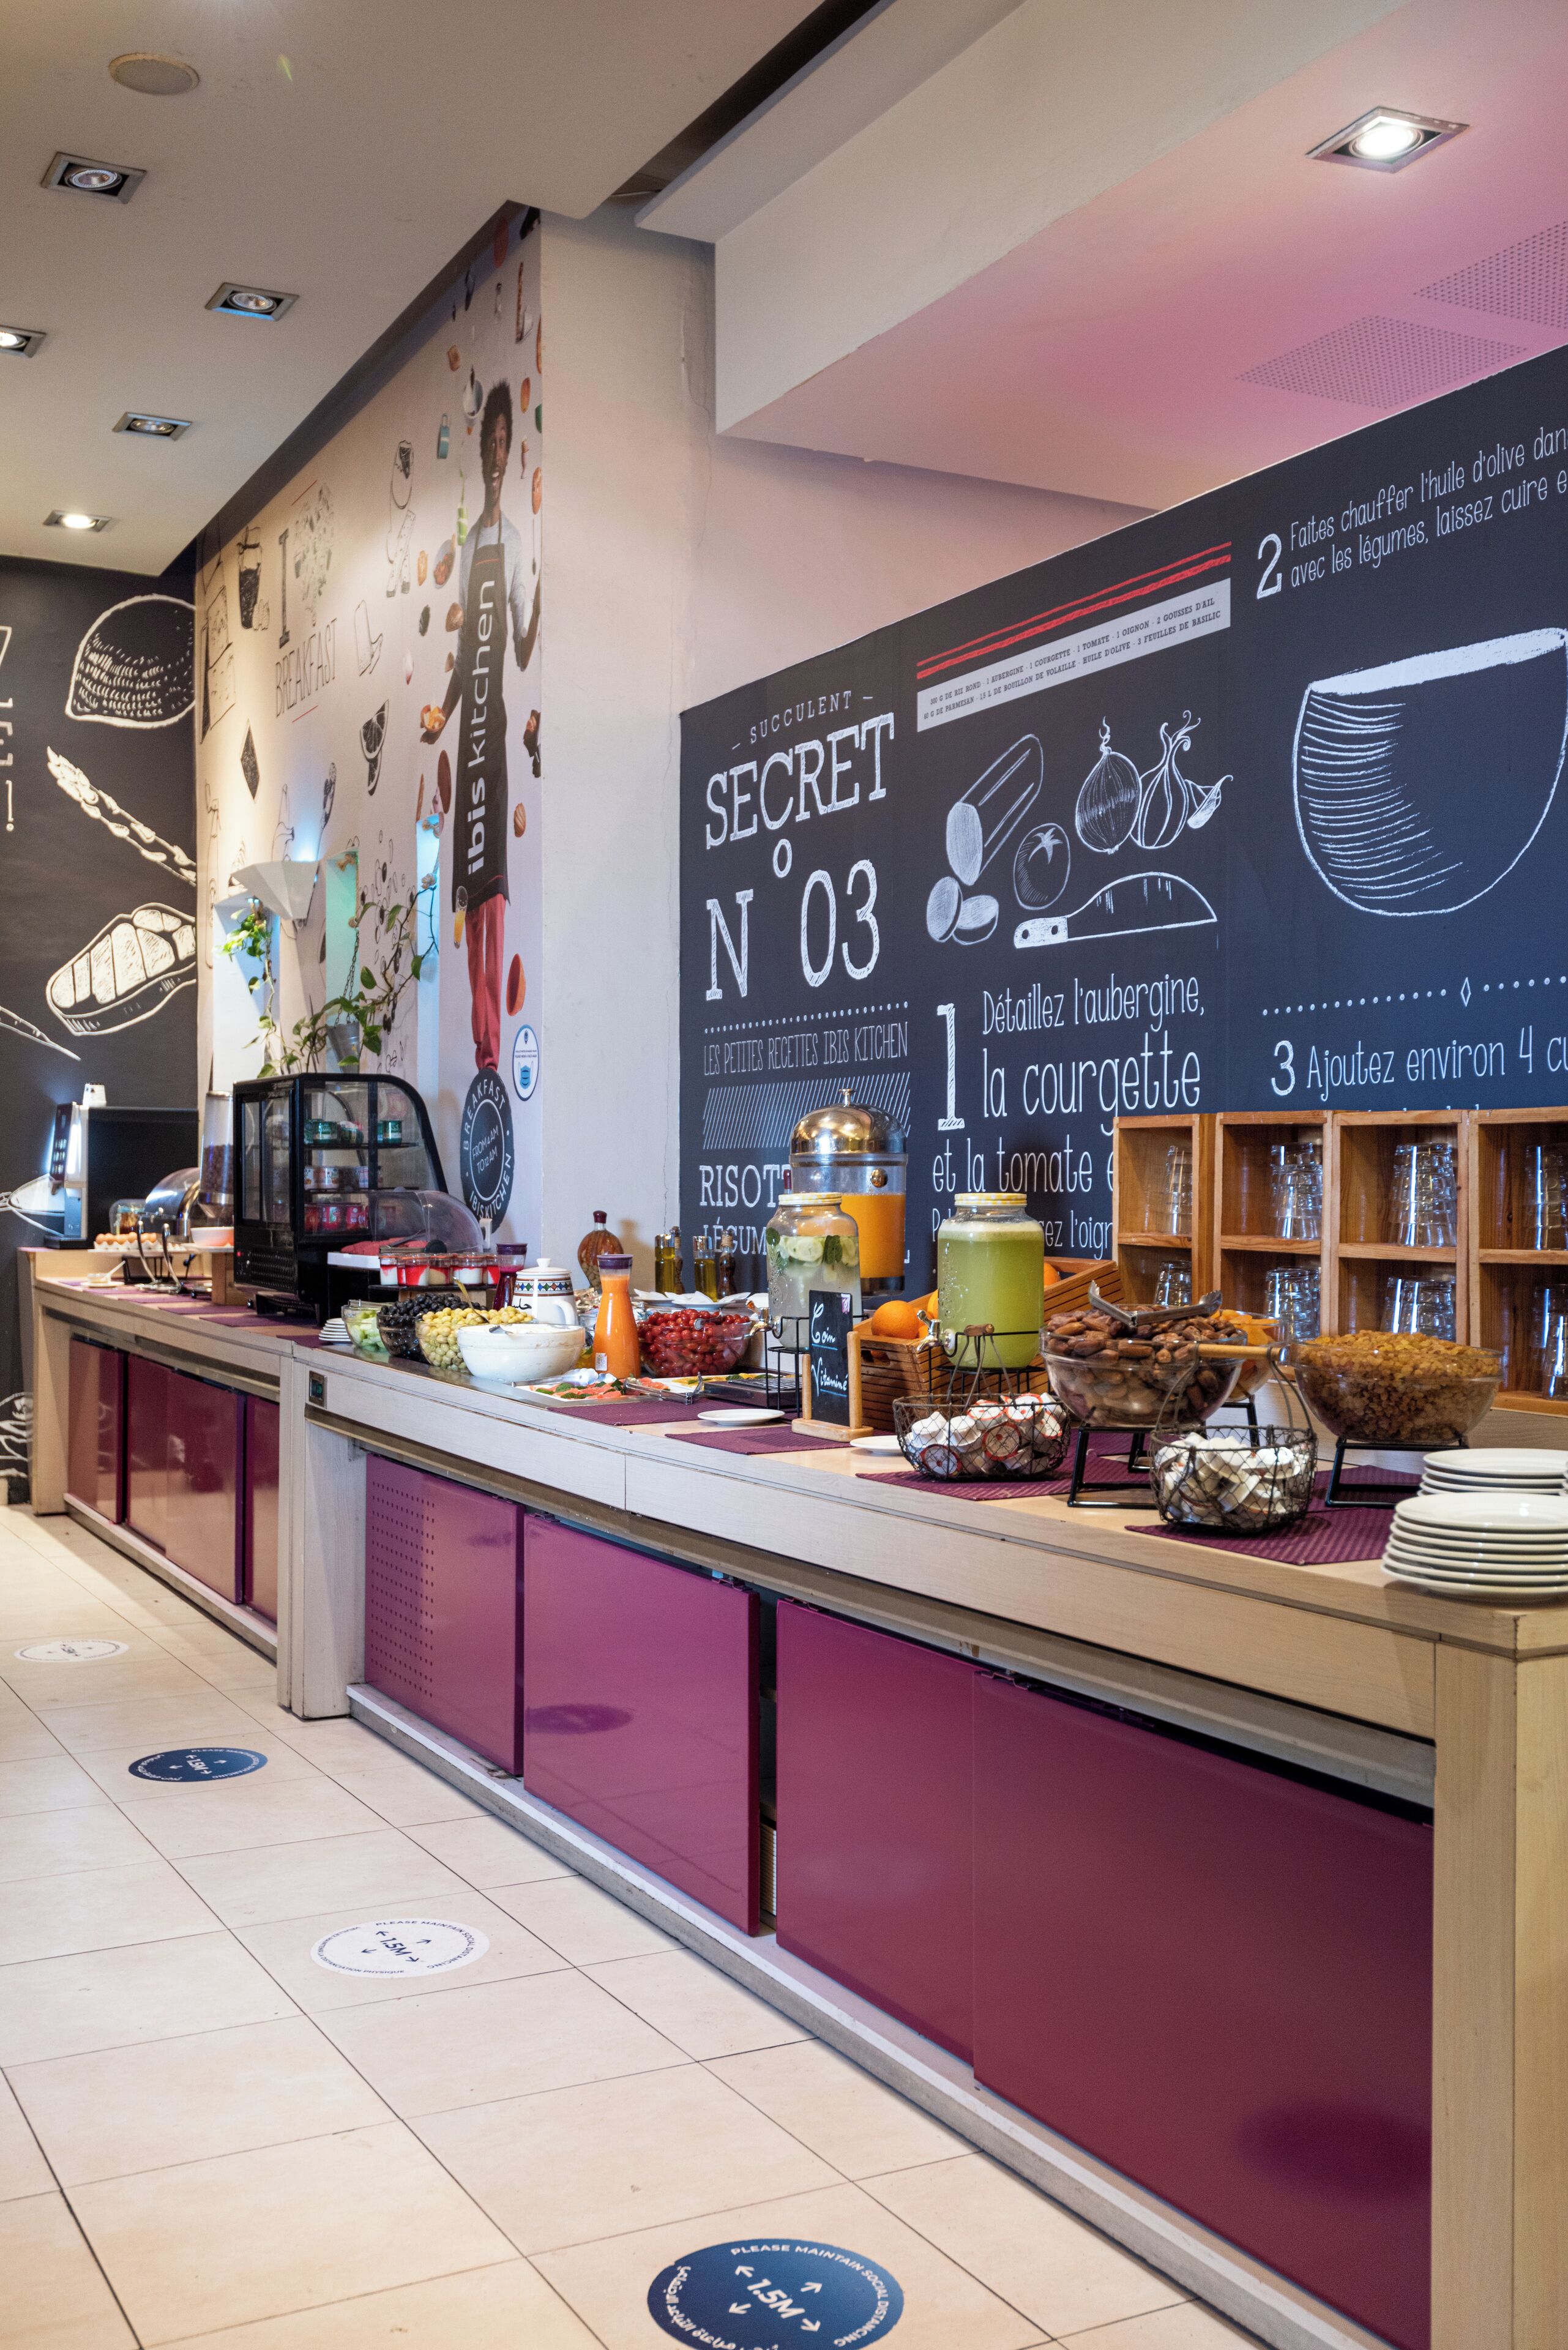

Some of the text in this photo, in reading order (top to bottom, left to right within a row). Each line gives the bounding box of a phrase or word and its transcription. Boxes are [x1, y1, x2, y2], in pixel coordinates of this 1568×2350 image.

[1290, 427, 1568, 551] Faites chauffer l'huile d'olive dan
[1291, 556, 1326, 588] avec
[1331, 543, 1352, 574] les
[1359, 521, 1428, 569] légumes,
[1436, 495, 1493, 537] laissez
[1501, 476, 1548, 513] cuire
[1256, 533, 1282, 600] 2
[275, 617, 337, 718] BREAKFAST
[936, 707, 944, 715] DE
[945, 696, 974, 712] PARMESAN
[993, 686, 1002, 695] DE
[1004, 674, 1033, 692] BOUILLON
[1035, 671, 1044, 681] DE
[1046, 660, 1076, 677] VOLAILLE
[1083, 651, 1102, 664] HUILE
[1105, 641, 1131, 657] D'OLIVE
[1144, 625, 1176, 643] FEUILLES
[1179, 621, 1189, 632] DE
[1192, 610, 1222, 627] BASILIC
[945, 692, 953, 700] DE
[965, 681, 981, 692] ROND
[991, 666, 1024, 683] AUBERGINE
[1034, 648, 1071, 667] COURGETTE
[1082, 635, 1110, 651] TOMATE
[1122, 620, 1150, 636] OIGNON
[1163, 605, 1193, 622] GOUSSES
[1196, 597, 1215, 611] D'AIL
[468, 580, 495, 875] ibis kitchen
[750, 690, 852, 744] SUCCULENT
[706, 712, 895, 849] SECRET
[801, 859, 880, 987] 03
[983, 973, 1205, 1035] Détaillez l'aubergine,
[704, 1021, 908, 1076] LES PETITES RECETTES IBIS KITCHEN
[937, 1003, 965, 1131] 1
[1271, 1040, 1296, 1095] 3
[1307, 1040, 1395, 1102] Ajoutez
[1407, 1039, 1506, 1081] environ
[1519, 1024, 1533, 1074] 4
[463, 1079, 506, 1151] BREAKFAST
[983, 1030, 1201, 1136] la courgette
[472, 1136, 487, 1160] FROM
[490, 1124, 499, 1143] AM
[477, 1158, 485, 1174] TO
[490, 1145, 498, 1163] AM
[933, 1139, 956, 1193] et
[967, 1138, 986, 1193] la
[996, 1134, 1093, 1193] tomate
[470, 1153, 512, 1219] IBIS KITCHEN
[811, 1302, 835, 1343] Coin
[379, 1937, 413, 1956] 1.5M
[421, 1920, 466, 1933] MAINTAIN
[427, 1947, 474, 1969] DISTANCING
[461, 1931, 476, 1947] SOCIAL
[731, 2244, 889, 2348] PLEASE MAINTAIN SOCIAL DISTANCING
[747, 2278, 805, 2319] 1.5M
